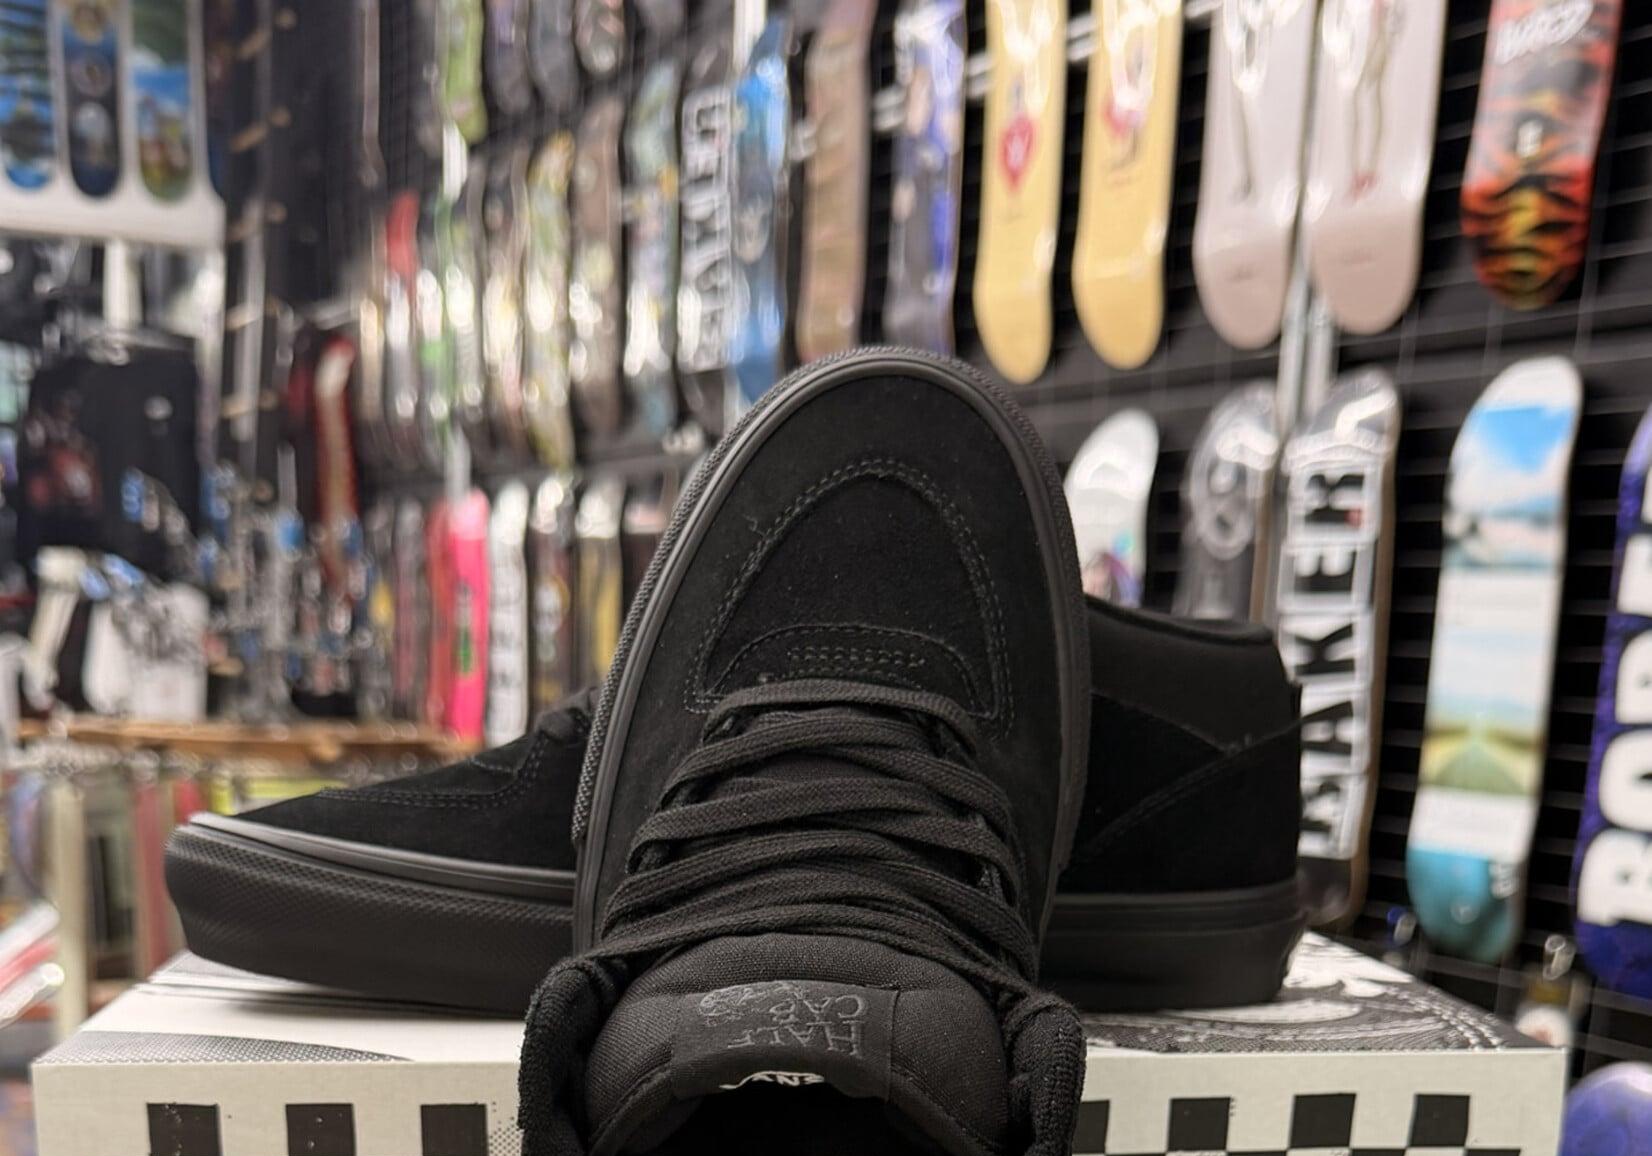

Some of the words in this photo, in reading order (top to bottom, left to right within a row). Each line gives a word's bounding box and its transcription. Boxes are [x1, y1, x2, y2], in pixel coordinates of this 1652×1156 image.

[1289, 466, 1371, 848] BAKER
[769, 994, 866, 1024] CAB
[728, 1020, 863, 1059] HALF
